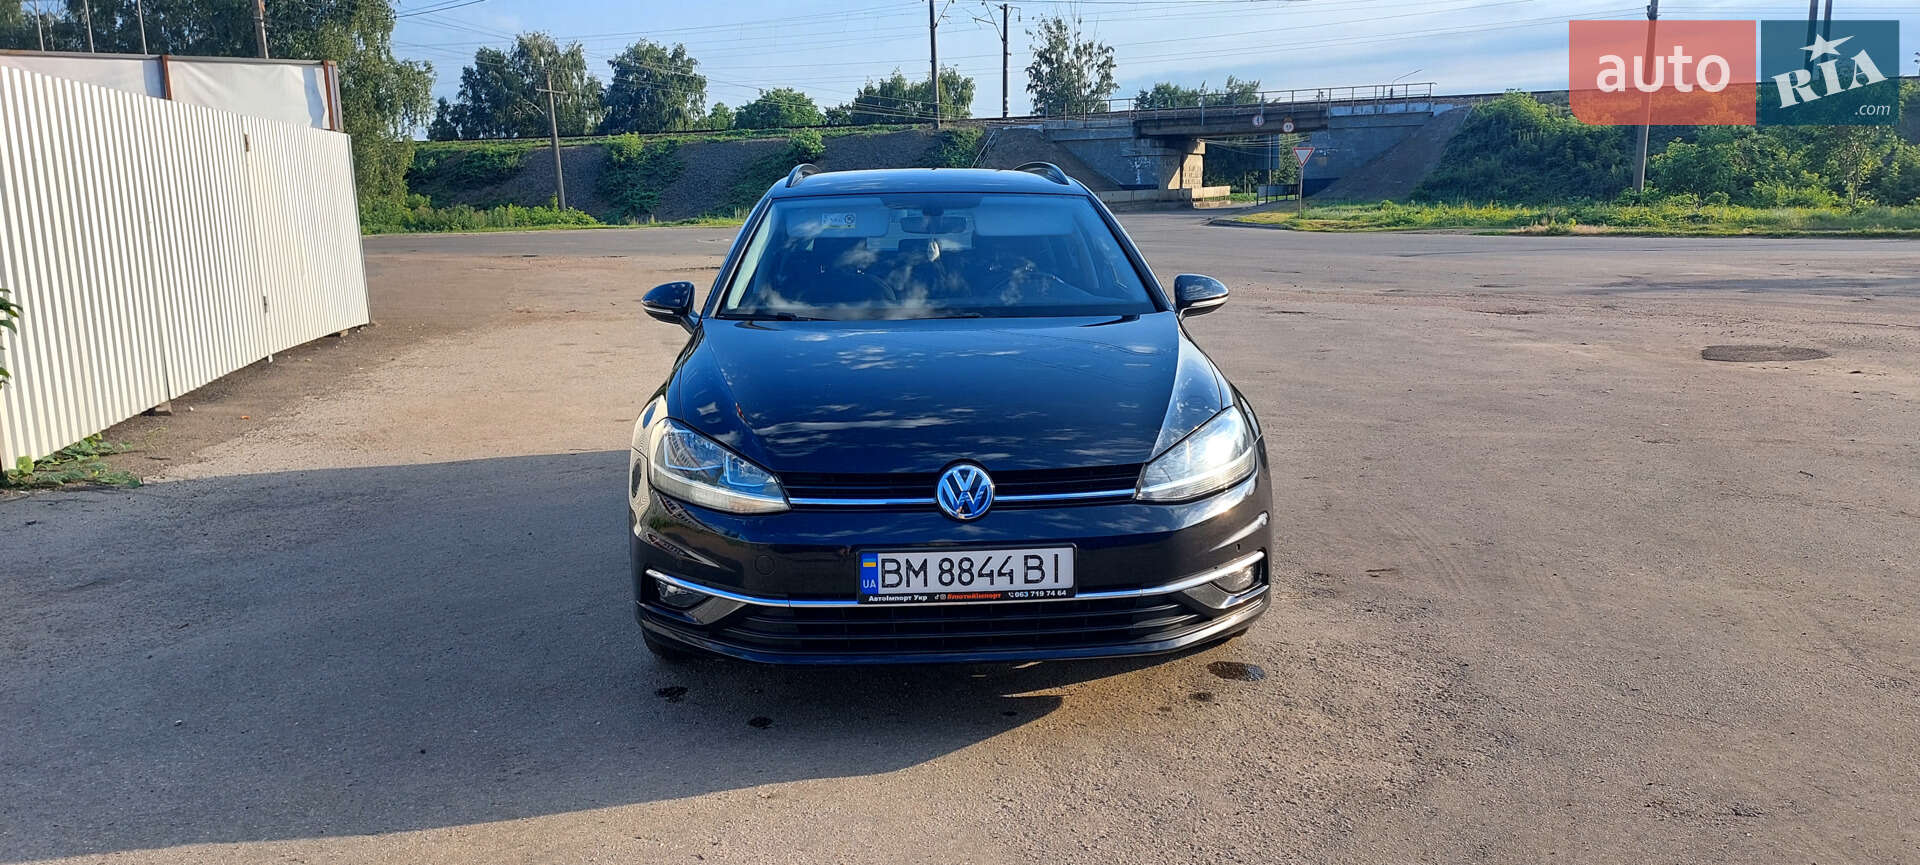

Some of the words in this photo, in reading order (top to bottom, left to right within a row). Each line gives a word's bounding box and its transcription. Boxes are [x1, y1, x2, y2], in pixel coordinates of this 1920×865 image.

[937, 465, 994, 519] VW
[880, 557, 928, 589] BM
[938, 555, 1014, 587] 8844
[1023, 553, 1059, 585] BI
[862, 579, 876, 589] UA
[913, 594, 928, 602] Укр
